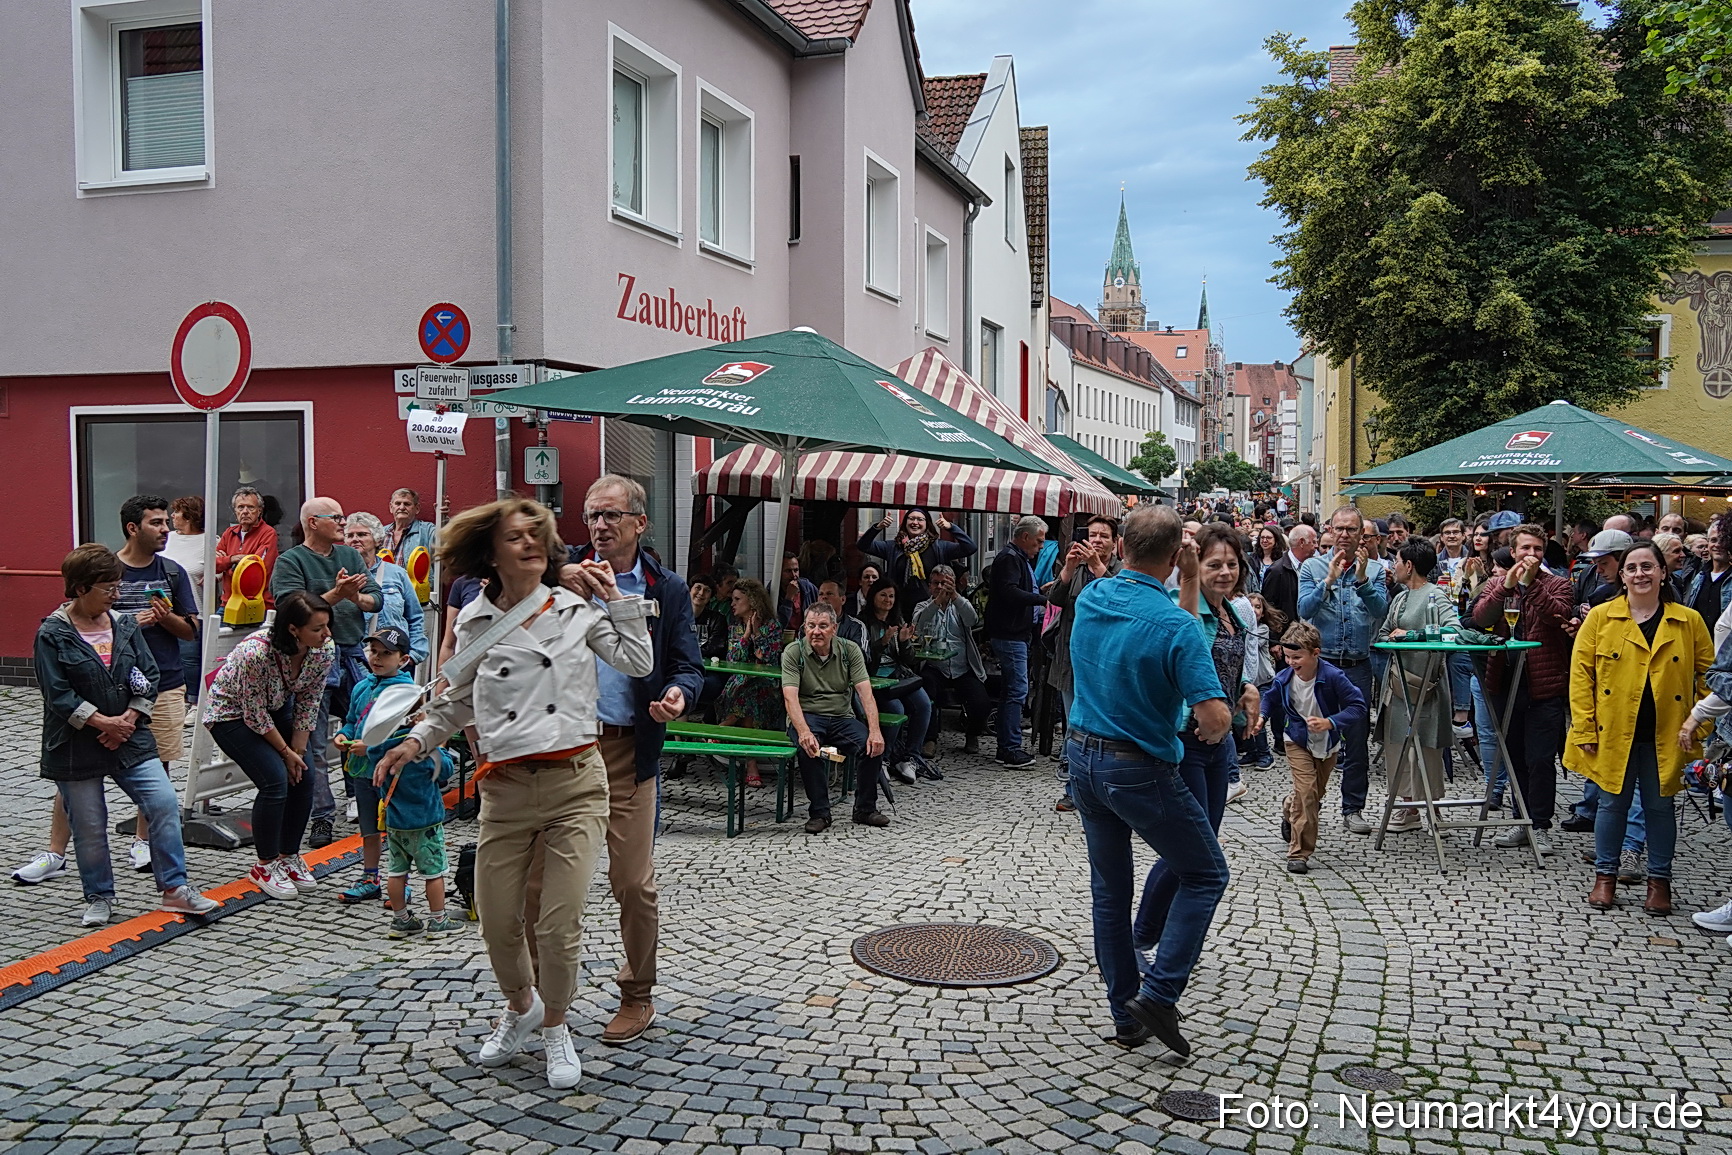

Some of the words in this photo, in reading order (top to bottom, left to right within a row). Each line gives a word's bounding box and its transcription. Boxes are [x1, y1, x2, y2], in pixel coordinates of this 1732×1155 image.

[617, 272, 747, 343] Zauberhaft
[420, 371, 466, 384] Feuerwehr-
[428, 385, 457, 397] zufahrt
[657, 389, 755, 403] Neumarkter
[626, 394, 761, 416] Lammsbräu
[411, 424, 458, 434] 20.06.2024
[416, 436, 438, 444] 13:00
[440, 437, 455, 445] Uhr
[1478, 452, 1553, 461] Neumarkter
[1458, 458, 1562, 468] Lammsbräu
